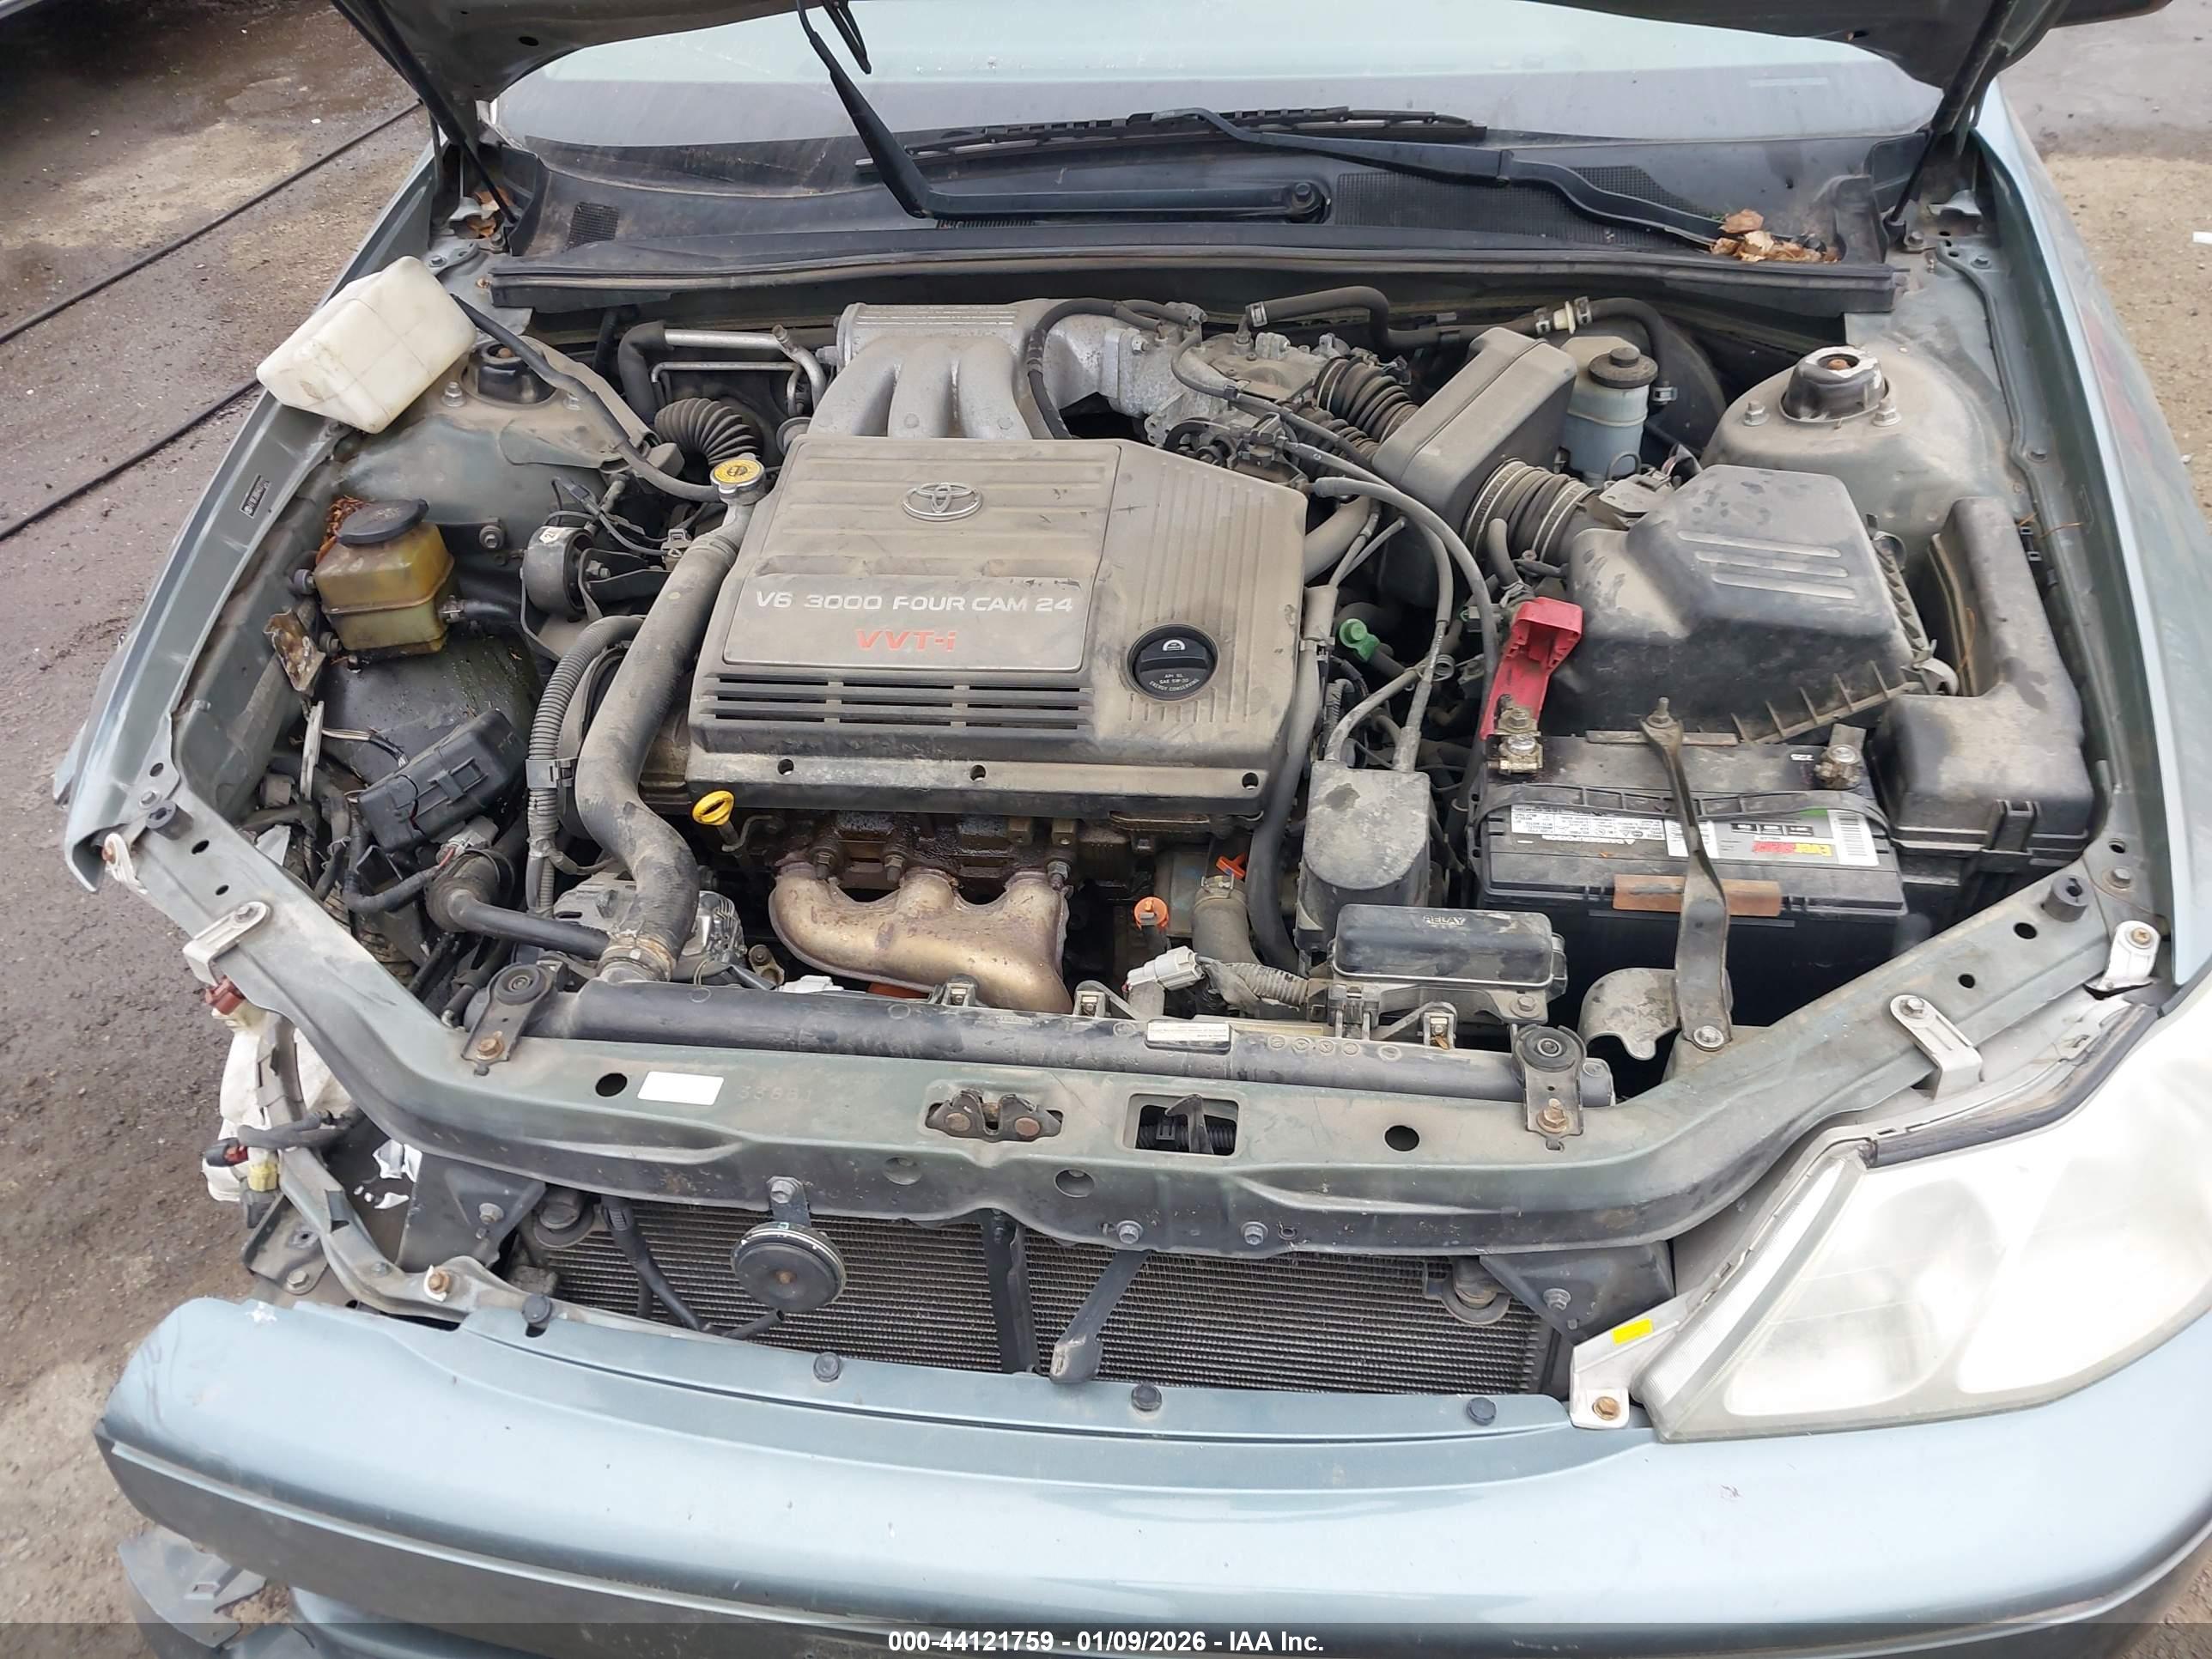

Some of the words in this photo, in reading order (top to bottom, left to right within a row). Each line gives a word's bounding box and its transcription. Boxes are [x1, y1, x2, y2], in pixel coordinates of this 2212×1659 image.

[756, 591, 793, 608] V6
[804, 594, 883, 610] 3000
[892, 596, 965, 611] FOUR
[971, 597, 1027, 611] CAM
[1035, 597, 1073, 612] 24
[855, 629, 957, 652] VVT-i
[1149, 680, 1169, 690] ENERGY
[1423, 915, 1467, 925] RELAY
